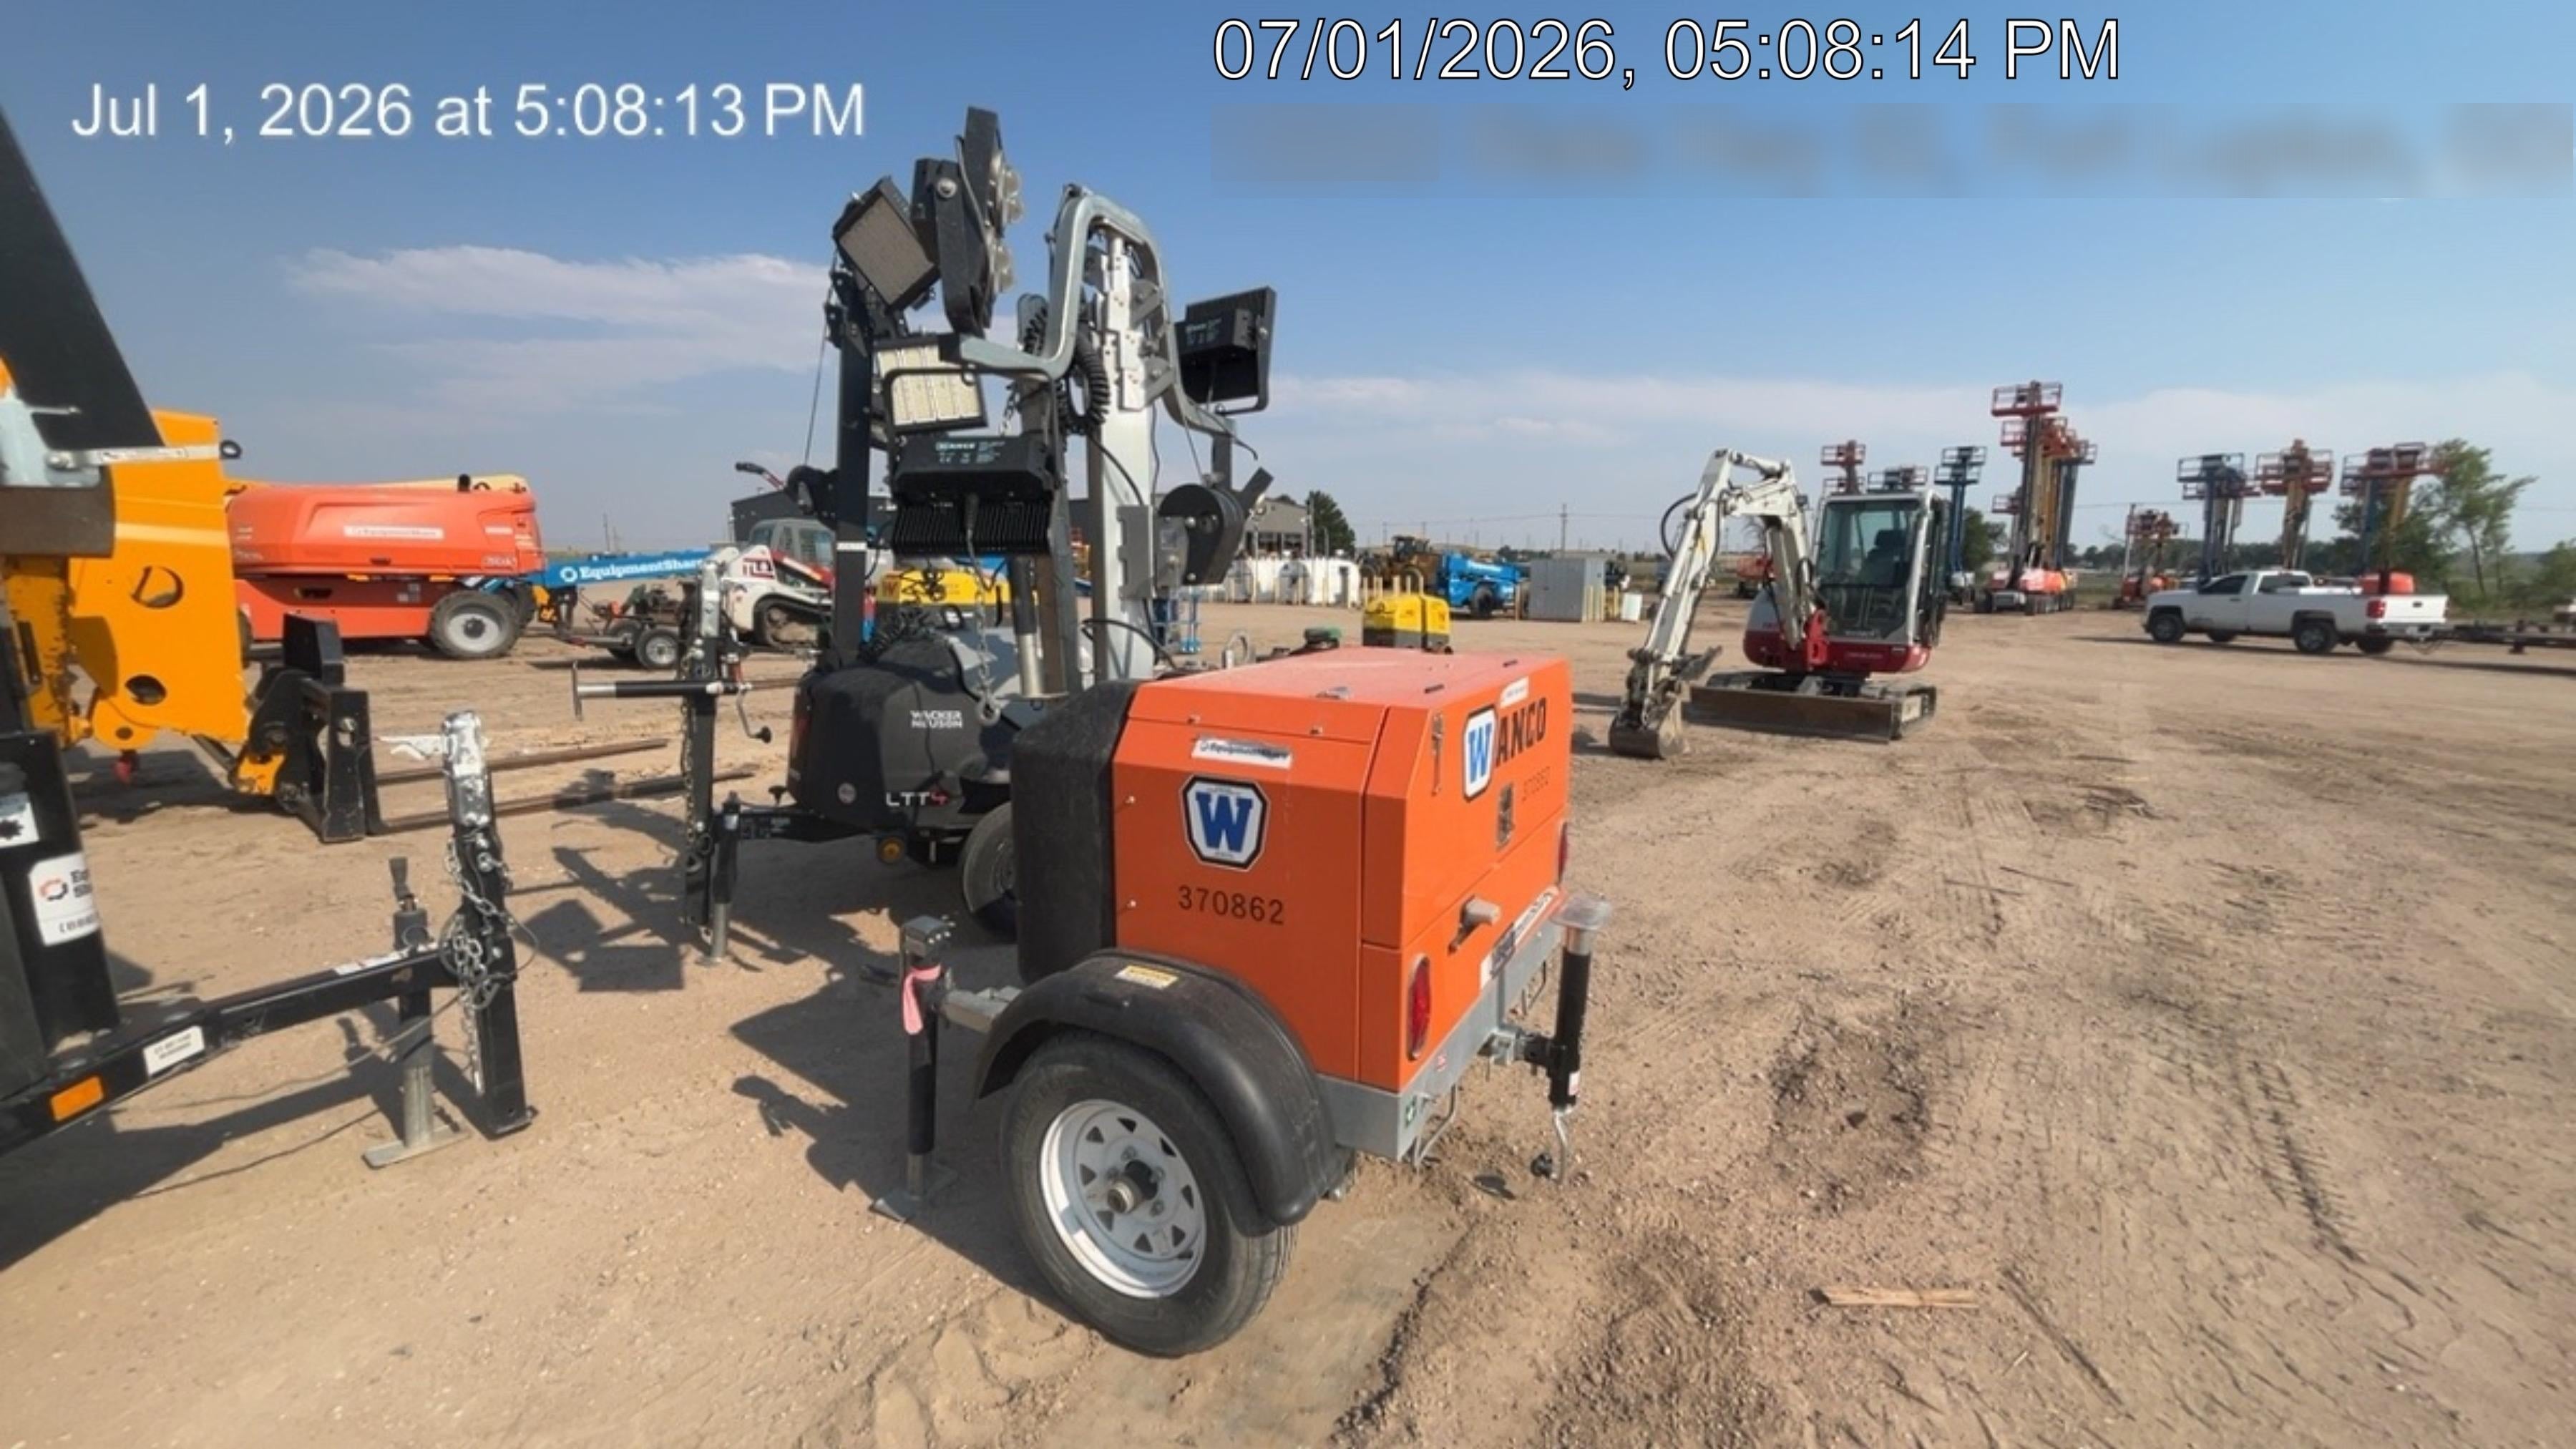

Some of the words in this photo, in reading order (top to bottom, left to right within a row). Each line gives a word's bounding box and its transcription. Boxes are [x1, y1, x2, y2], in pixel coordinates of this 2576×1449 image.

[579, 556, 707, 580] EquipmentShar
[1196, 791, 1254, 852] W
[1179, 884, 1284, 926] 370862
